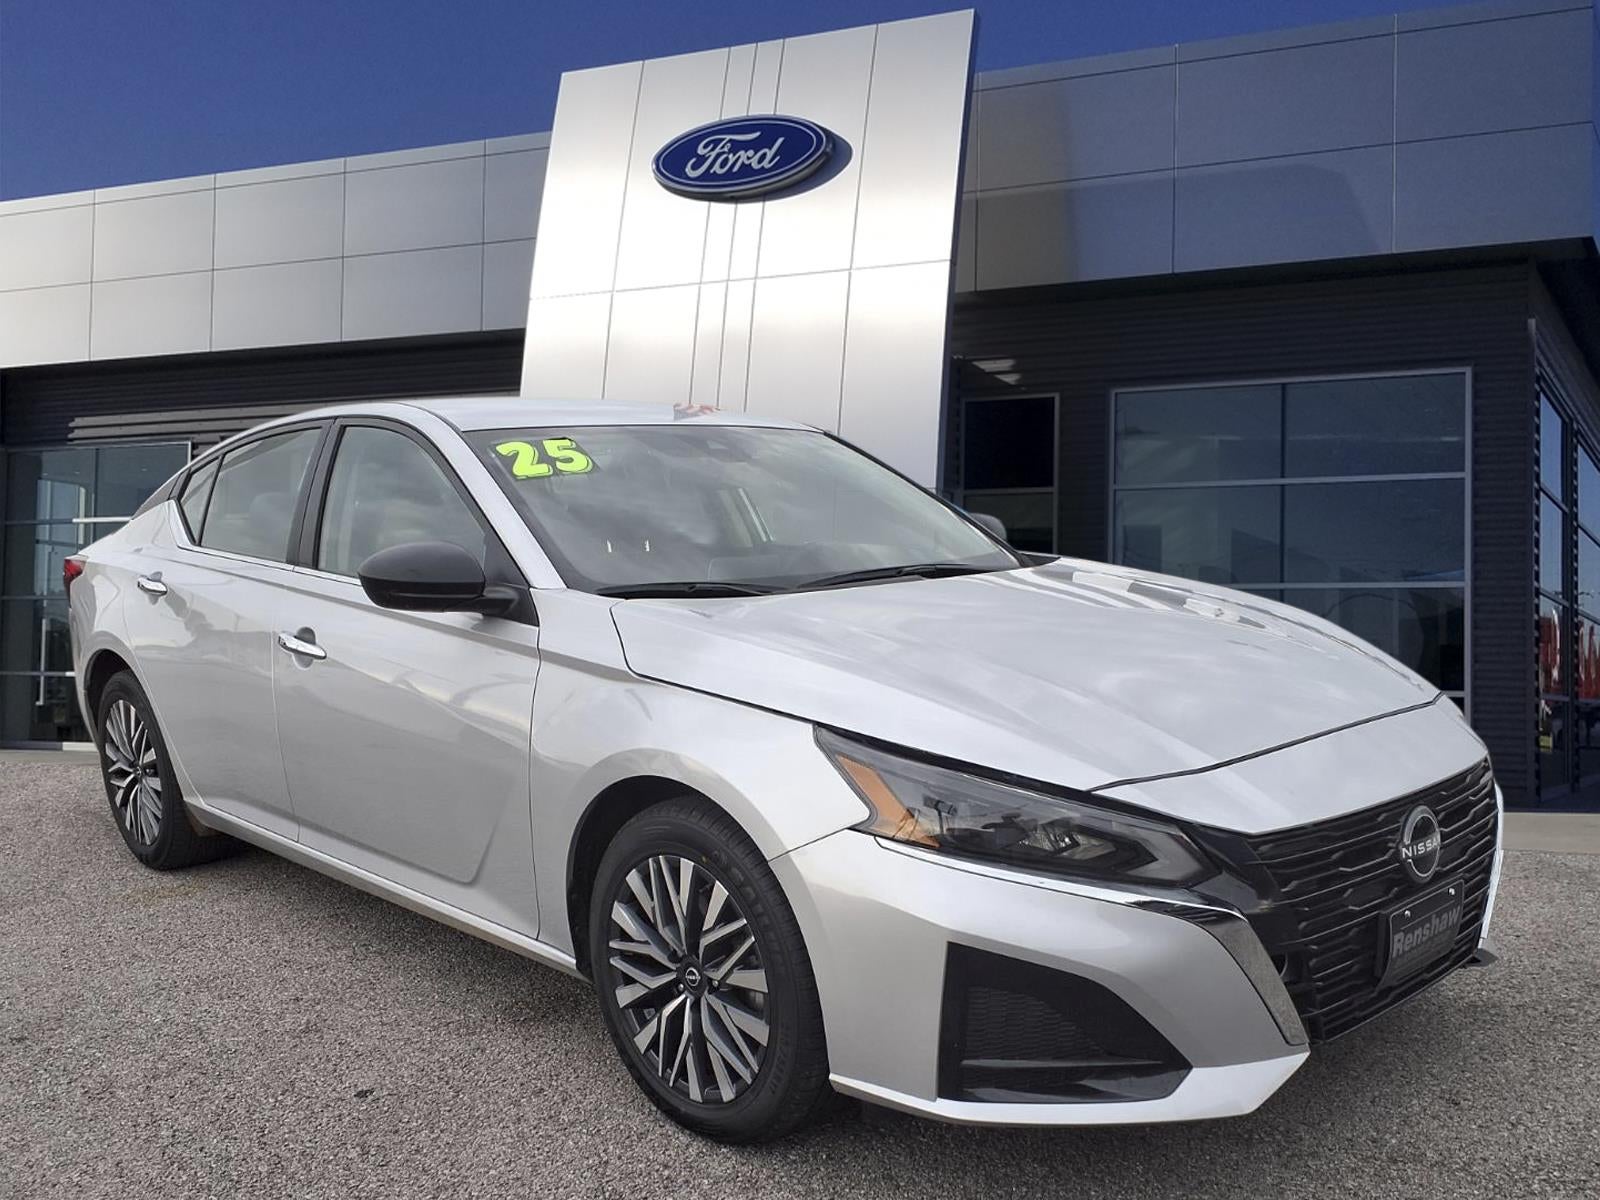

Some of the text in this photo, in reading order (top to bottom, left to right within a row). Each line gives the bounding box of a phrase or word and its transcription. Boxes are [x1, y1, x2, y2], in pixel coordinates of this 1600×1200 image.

[686, 132, 783, 177] Ford
[496, 438, 592, 478] 25
[1402, 836, 1440, 858] NISSA
[1393, 906, 1460, 957] Renshaw
